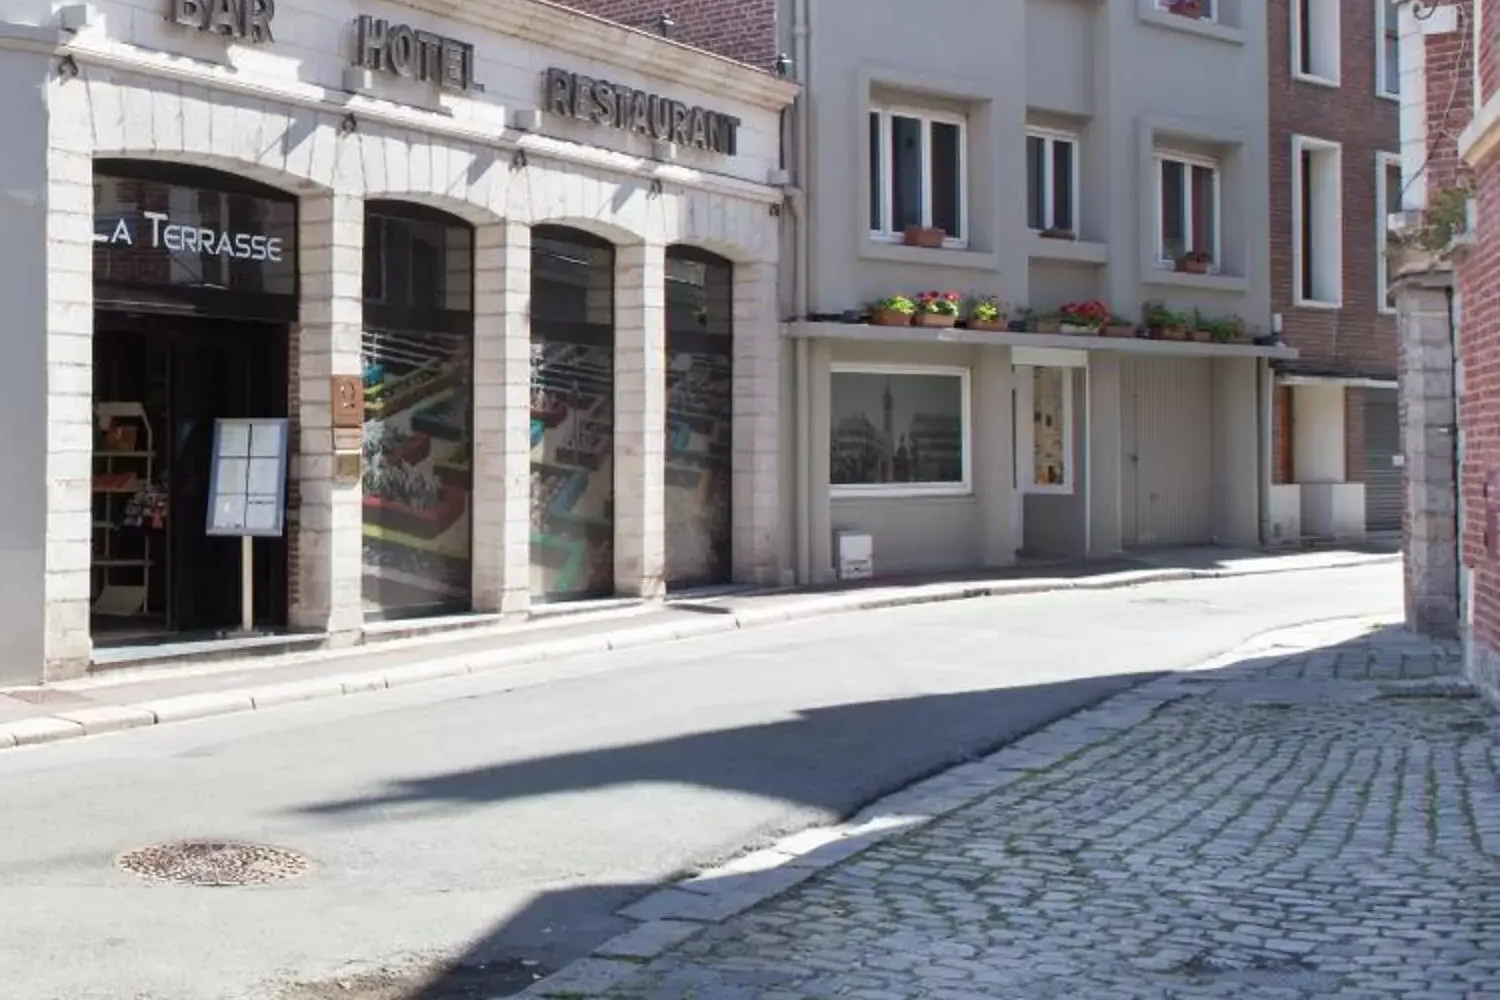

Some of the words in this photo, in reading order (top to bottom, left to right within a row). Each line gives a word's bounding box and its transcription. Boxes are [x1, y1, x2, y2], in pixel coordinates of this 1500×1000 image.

[357, 14, 485, 93] HOTEL
[546, 67, 741, 156] RESTAURANT
[143, 211, 284, 262] TERRASSE
